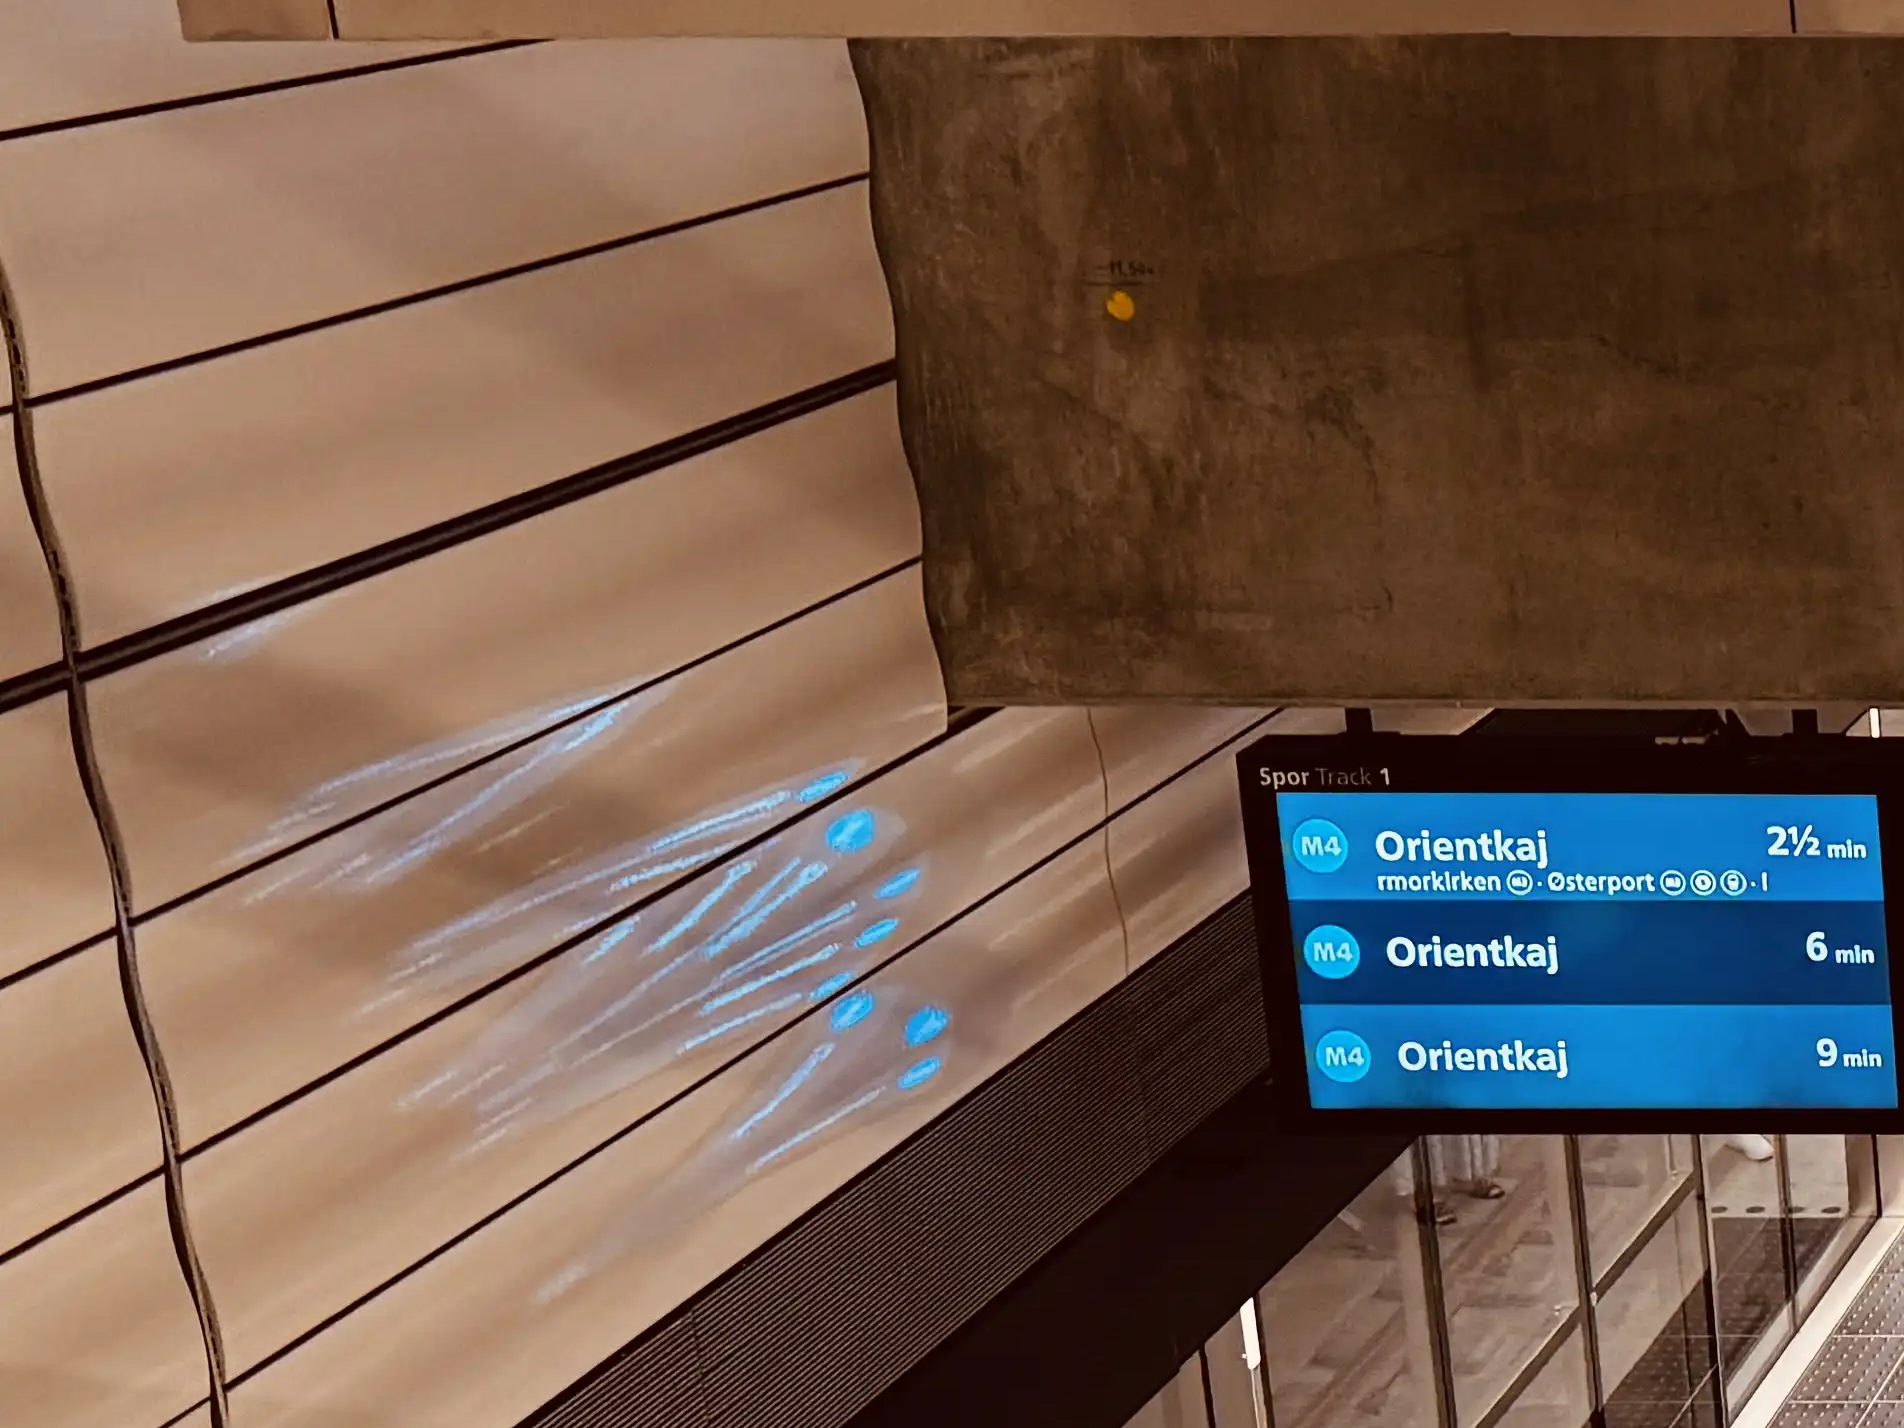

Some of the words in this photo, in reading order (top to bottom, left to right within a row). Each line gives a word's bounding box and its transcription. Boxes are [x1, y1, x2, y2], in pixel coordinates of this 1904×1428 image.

[1259, 767, 1309, 790] Spor
[1315, 767, 1371, 786] Track
[1379, 767, 1390, 786] 1
[1301, 836, 1342, 857] M4
[1375, 829, 1549, 869] Orientkaj
[1827, 838, 1867, 859] min
[1547, 872, 1656, 896] Østerport
[1313, 942, 1353, 963] M4
[1386, 934, 1559, 975] Orientkaj
[1806, 931, 1828, 962] 6
[1834, 943, 1875, 964] min
[1325, 1046, 1365, 1067] M4
[1398, 1039, 1568, 1079] Orientkaj
[1816, 1039, 1839, 1068] 9
[1843, 1047, 1882, 1068] min
